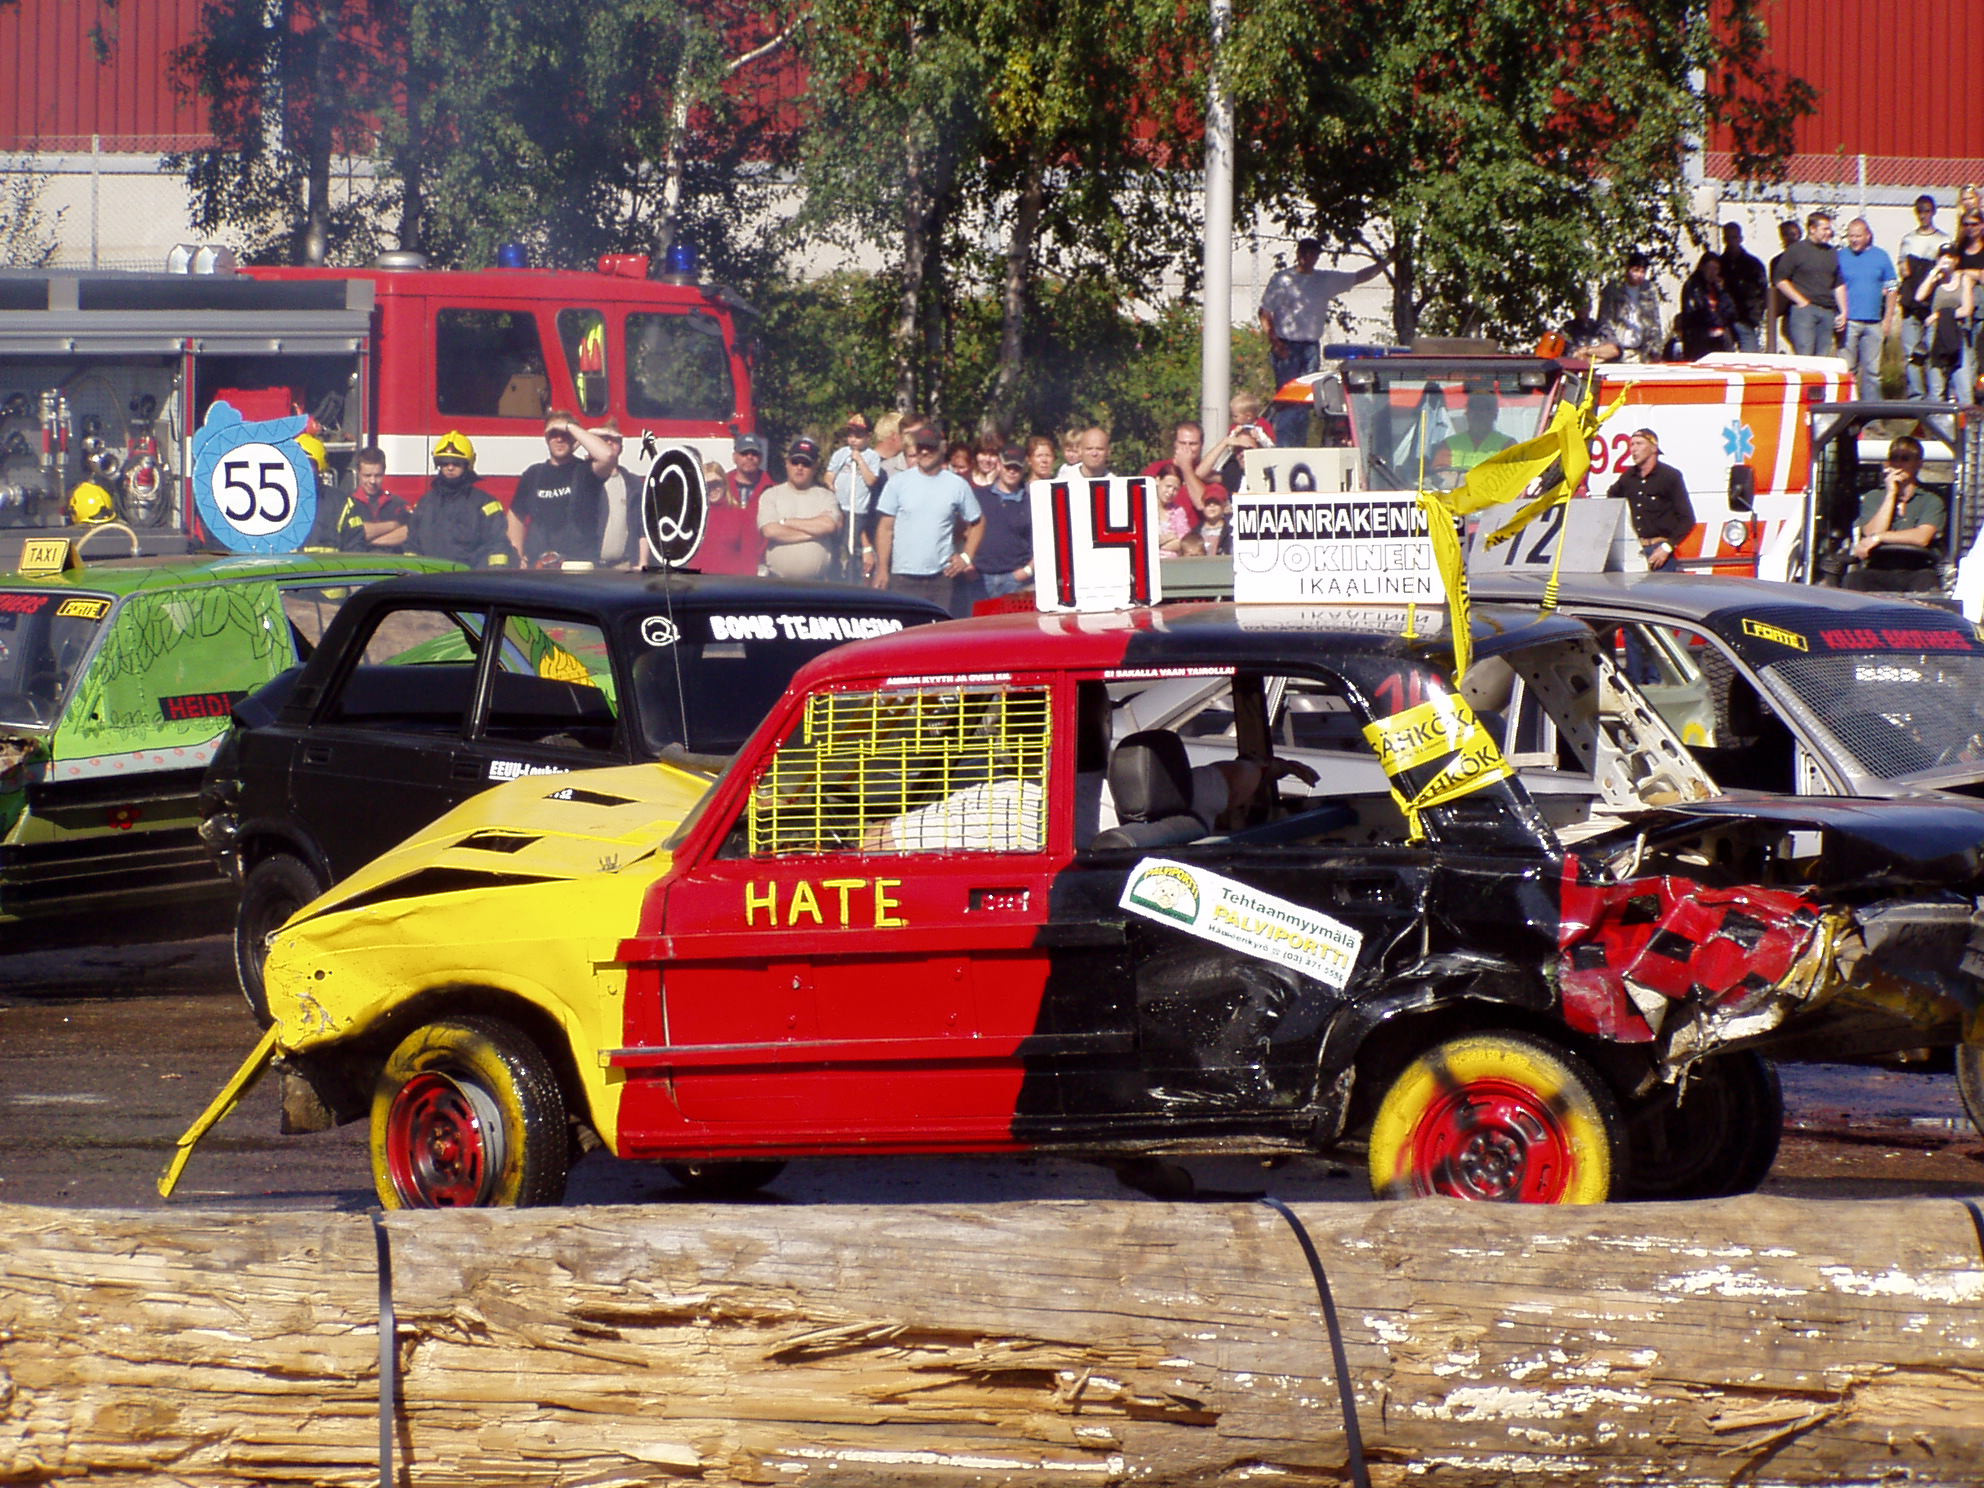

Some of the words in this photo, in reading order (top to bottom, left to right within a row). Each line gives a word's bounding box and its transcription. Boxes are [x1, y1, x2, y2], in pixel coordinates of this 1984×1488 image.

[224, 460, 291, 523] 55
[1238, 506, 1464, 535] MAANRAKENN
[30, 547, 57, 562] TAXI
[1050, 477, 1152, 607] 14
[1300, 577, 1431, 595] IKAALINEN
[709, 615, 777, 641] BOMB
[776, 615, 843, 641] TEAM
[167, 693, 231, 719] HEIDI
[745, 878, 904, 930] HATE
[1222, 887, 1356, 949] Tehtaanmyymälä
[1213, 904, 1349, 970] PALVIPORTTI
